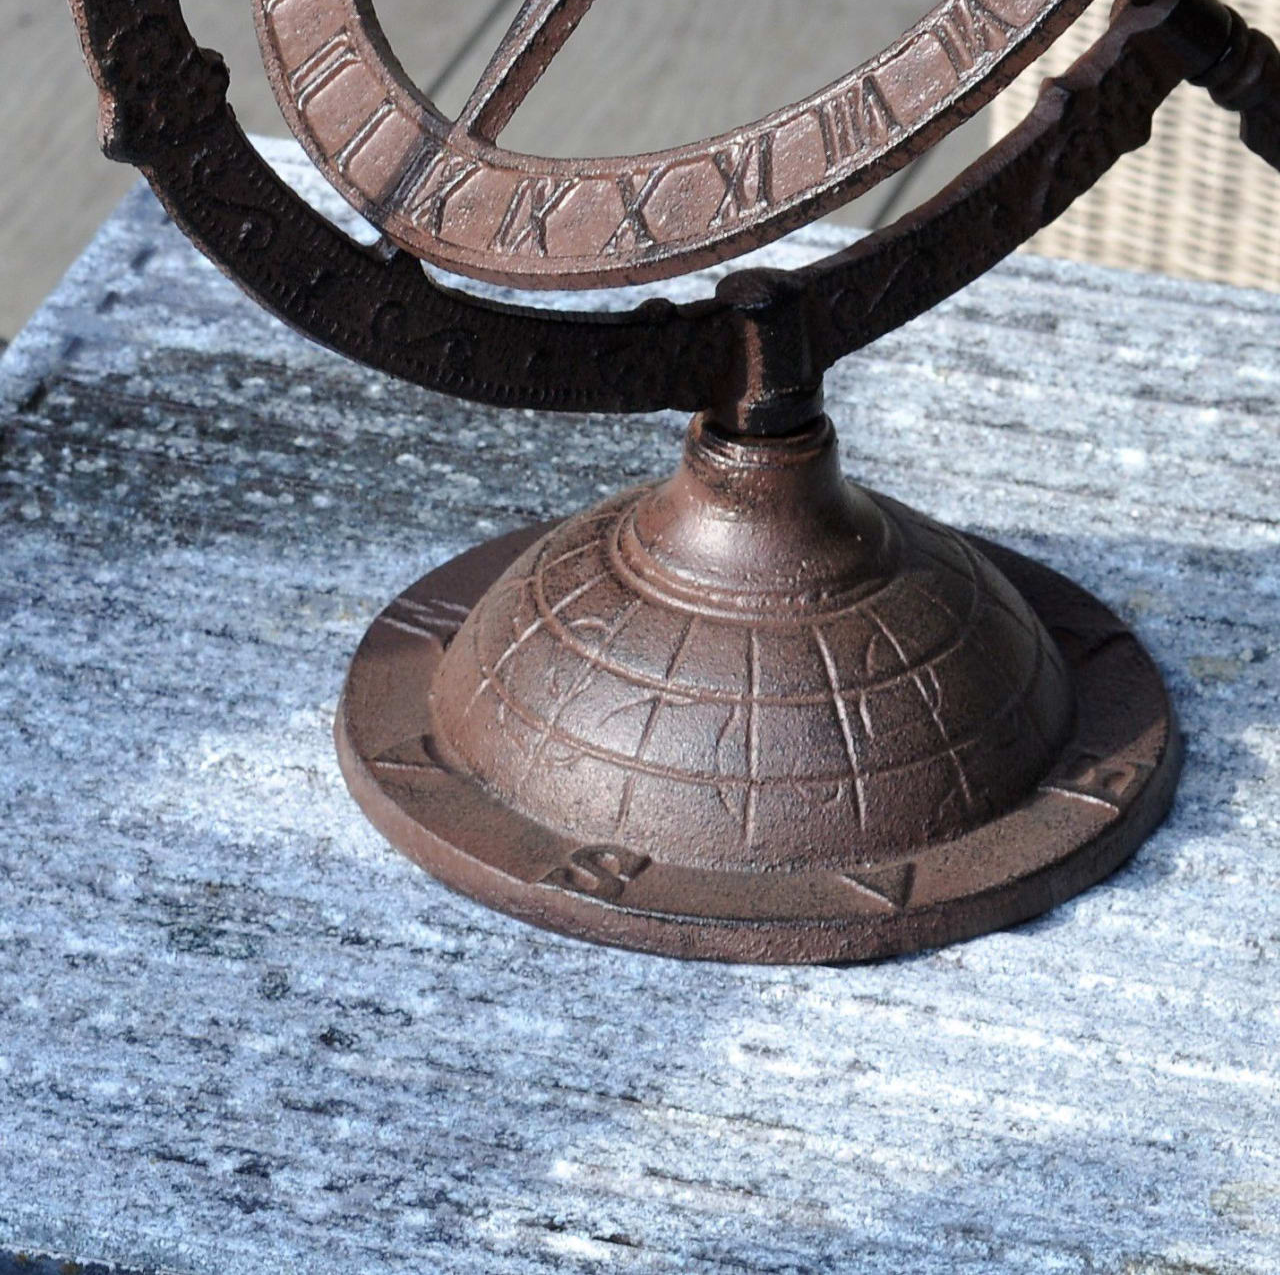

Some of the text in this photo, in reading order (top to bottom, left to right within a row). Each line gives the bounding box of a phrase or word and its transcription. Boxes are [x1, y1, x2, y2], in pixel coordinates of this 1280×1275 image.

[288, 25, 362, 111] II
[334, 101, 397, 173] I
[598, 165, 666, 257] X
[537, 843, 652, 907] S
